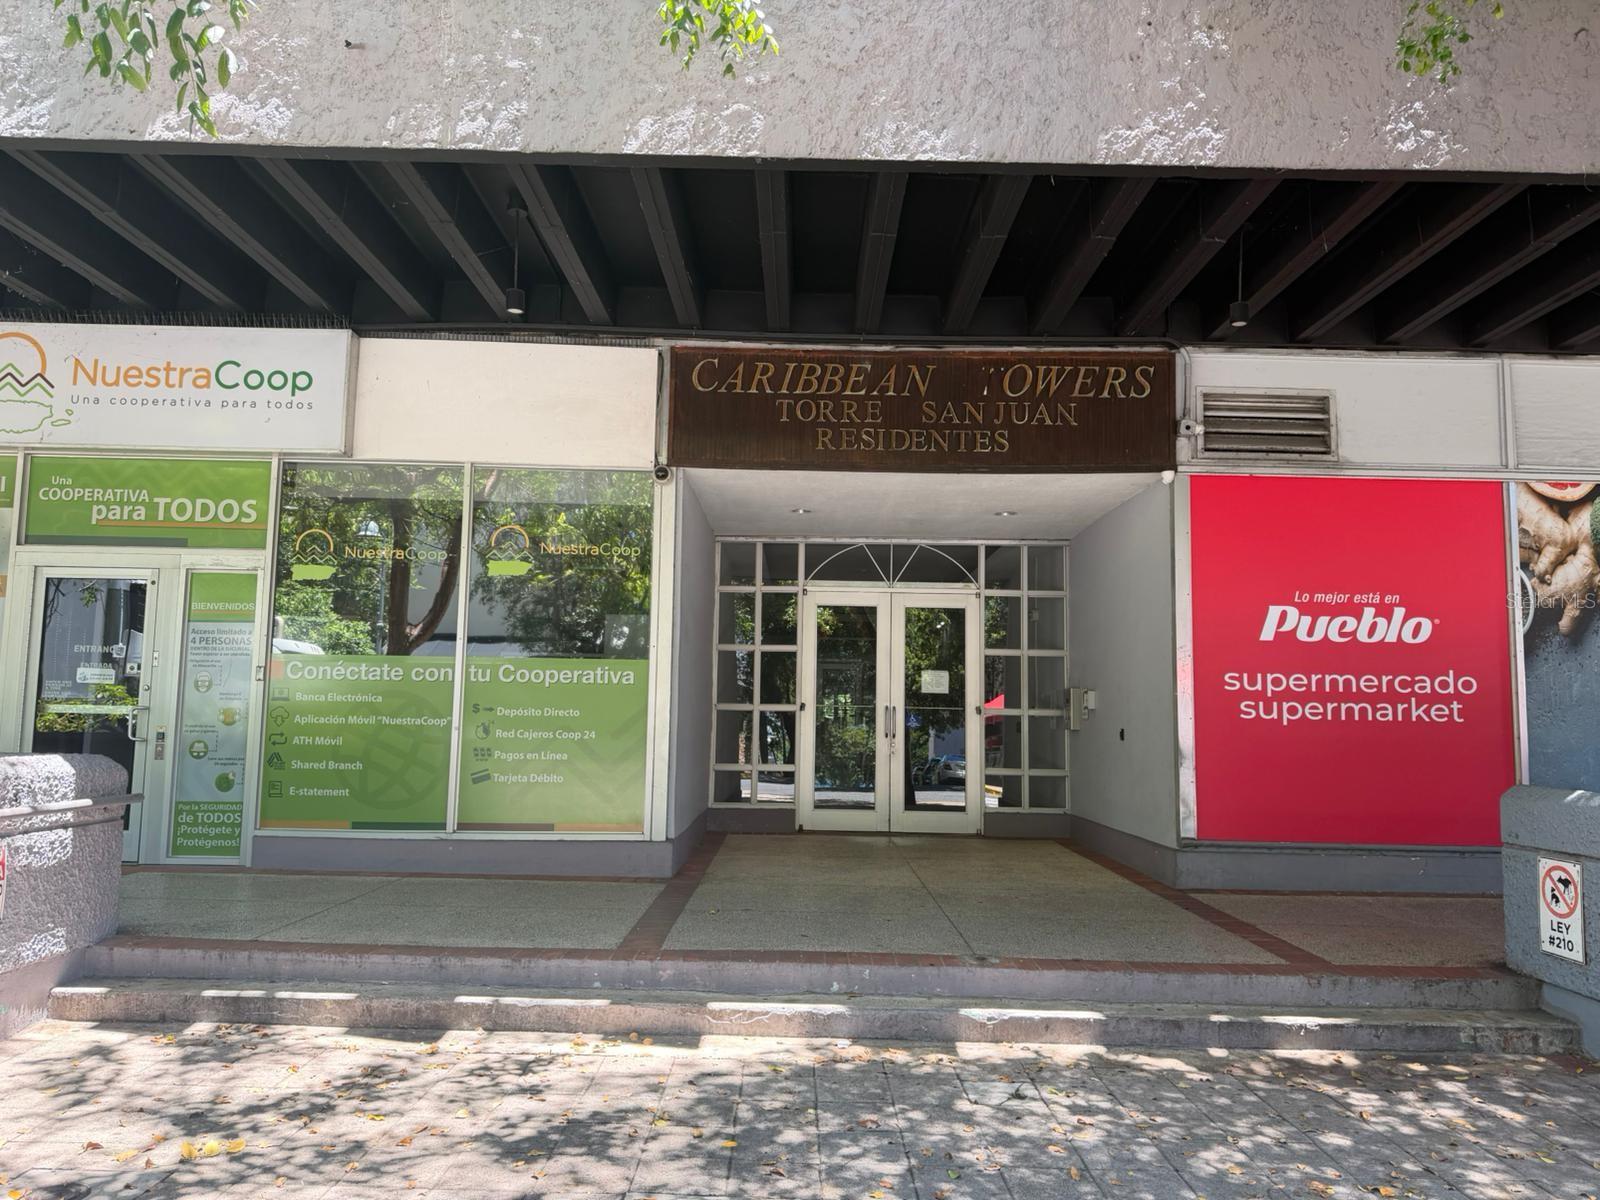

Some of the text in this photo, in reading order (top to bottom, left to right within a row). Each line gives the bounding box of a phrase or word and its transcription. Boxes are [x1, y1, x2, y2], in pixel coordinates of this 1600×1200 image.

[72, 358, 314, 397] NuestraCoop
[691, 358, 1155, 399] CARIBBEAN OWERS
[71, 395, 314, 411] Una cooperativa para todos
[776, 400, 1079, 427] TORRE SAN JUAN
[815, 428, 1010, 454] RESIDENTES
[51, 476, 73, 486] Una
[39, 487, 149, 503] COOPERATIVA
[91, 497, 258, 525] para TODOS
[345, 545, 448, 561] NuestraCoop
[540, 542, 641, 558] NuestraCoop
[1294, 591, 1400, 606] Lo mejor está en
[191, 602, 255, 611] BIENVENIDOS
[1259, 604, 1433, 645] Pueblo
[190, 636, 252, 646] 4 PERSONAS
[286, 660, 635, 688] Conéctate con tu Cooperativa
[1223, 670, 1478, 698] supermercado
[295, 691, 383, 703] Banca Electrónica
[496, 706, 581, 719] Depósito Directo
[1239, 697, 1465, 726] supermarket
[294, 714, 346, 726] Aplicación
[348, 714, 375, 725] Móvil
[293, 735, 343, 746] ATH Móvil
[496, 729, 596, 742] Red Cajeros Coop 24
[494, 750, 568, 762] Pagos en Línea
[291, 760, 363, 771] Shared Branch
[493, 773, 564, 785] Tarjeta Débito
[289, 787, 350, 798] E-statement
[199, 803, 243, 811] SEGURIDAD
[178, 812, 242, 824] de TODOS
[177, 824, 241, 837] ¡Protégete y
[176, 837, 240, 849] Protégenos!
[1550, 919, 1571, 935] LEY
[1548, 935, 1574, 952] #210
